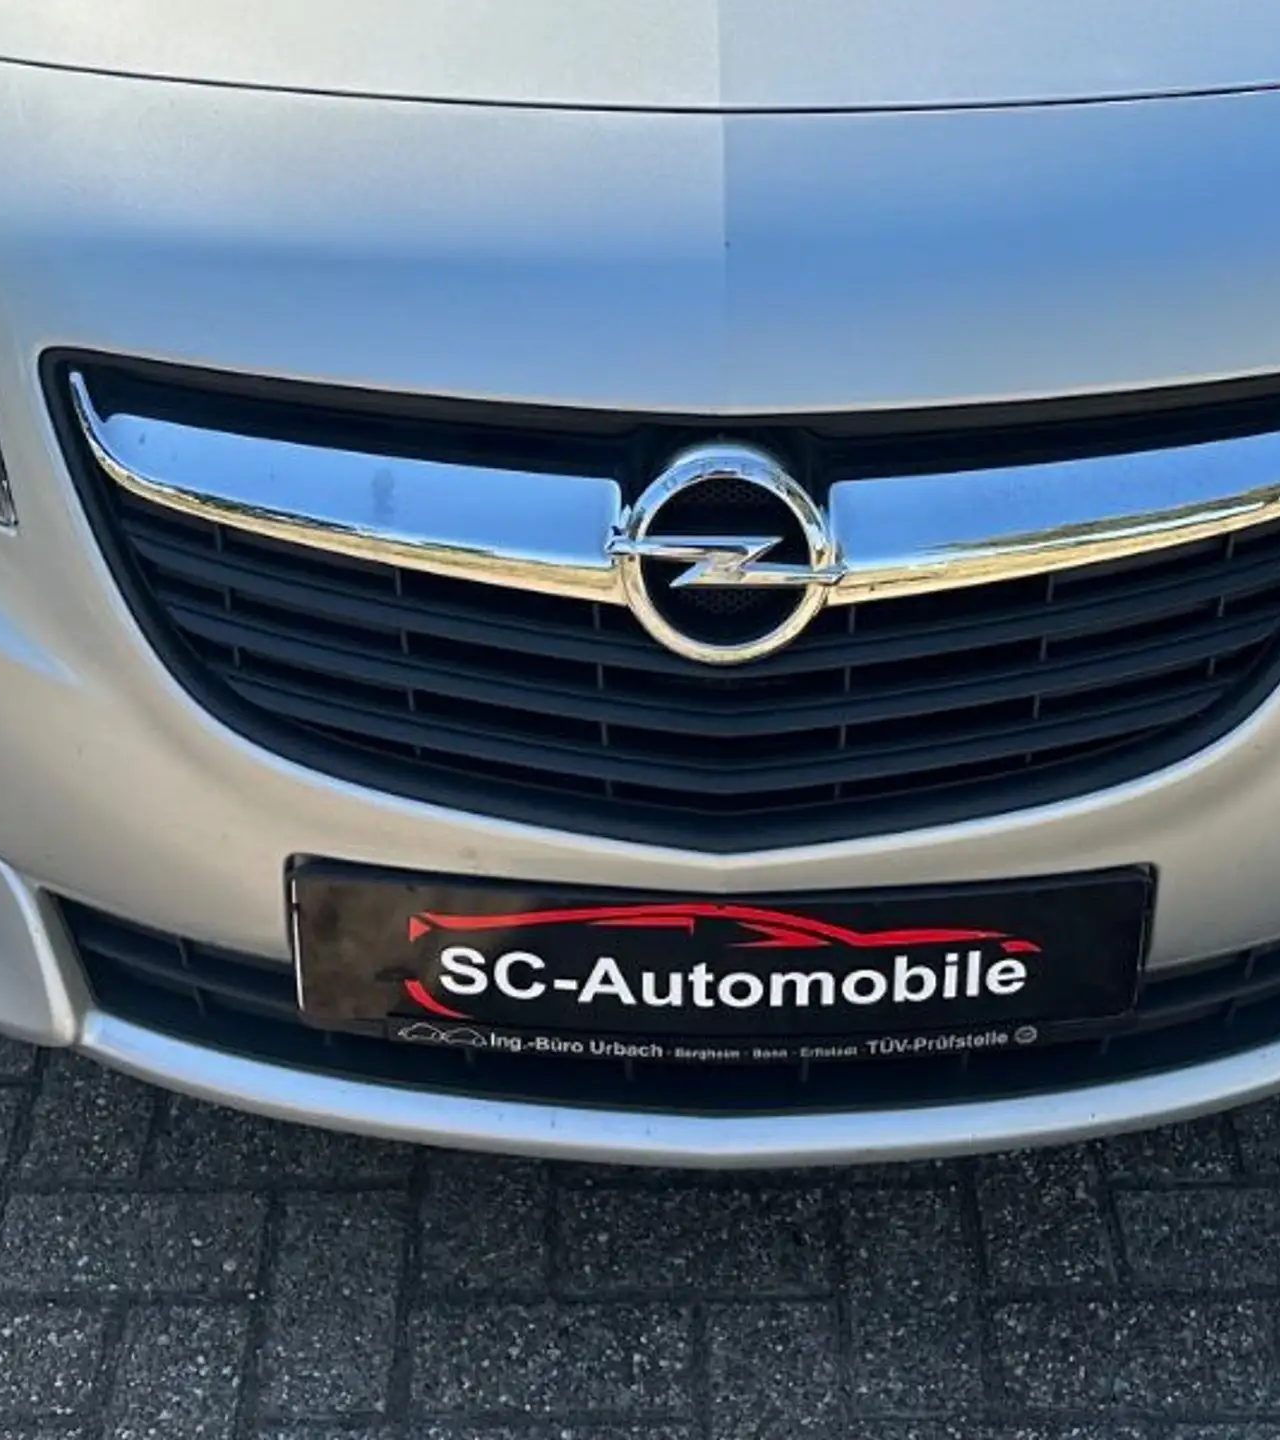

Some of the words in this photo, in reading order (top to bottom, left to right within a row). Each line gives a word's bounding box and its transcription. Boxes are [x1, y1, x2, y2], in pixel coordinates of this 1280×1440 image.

[438, 946, 1028, 1008] SC-Automobile
[489, 1032, 584, 1054] Ing.-Büro
[589, 1041, 664, 1058] Urbach
[865, 1029, 1009, 1056] TÜV-Prüfstelle
